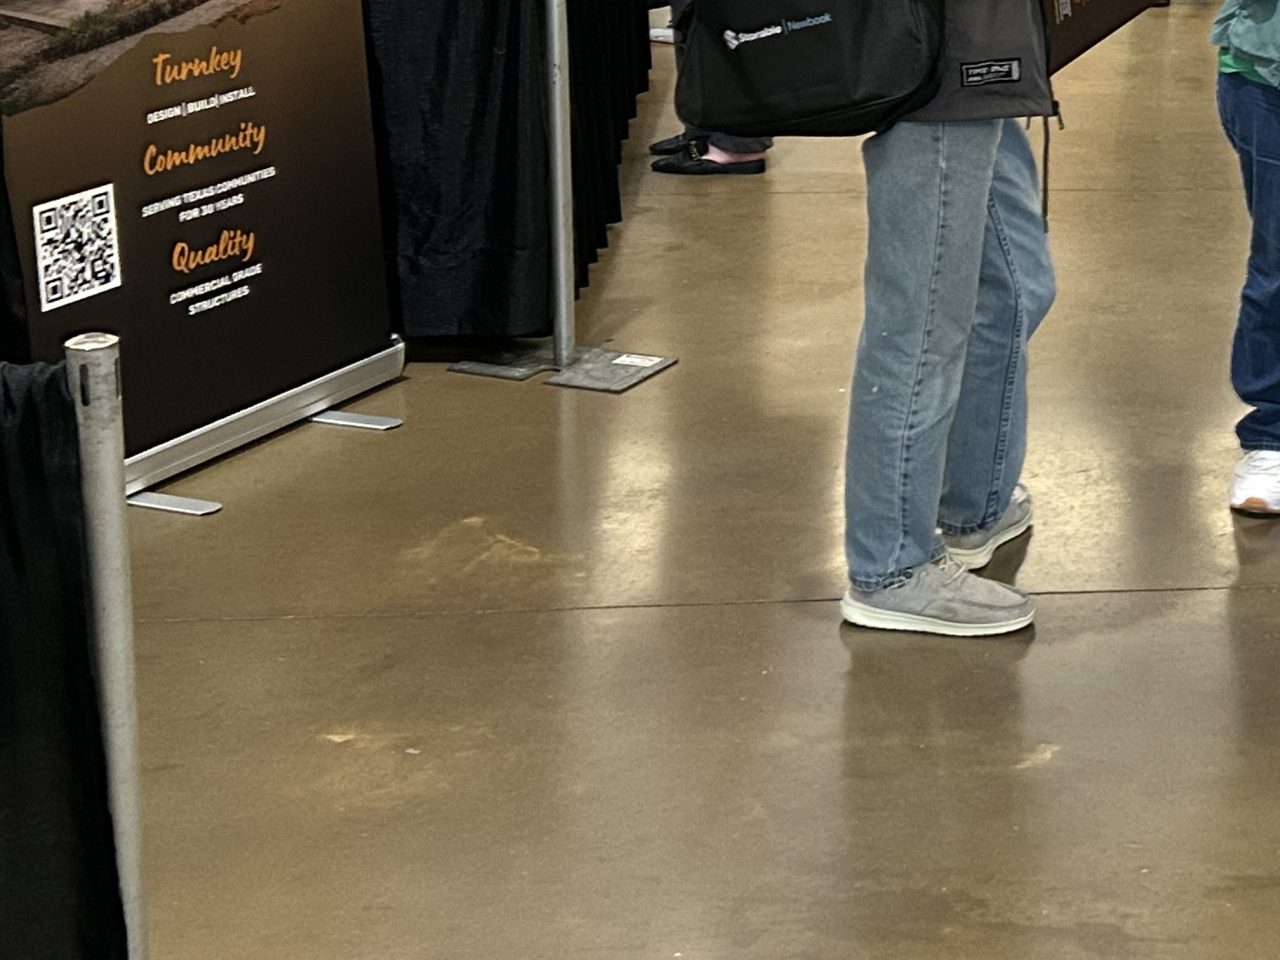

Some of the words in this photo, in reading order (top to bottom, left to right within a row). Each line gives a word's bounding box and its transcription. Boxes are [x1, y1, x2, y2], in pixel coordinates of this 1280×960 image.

[152, 46, 243, 86] Turnkey
[147, 105, 182, 124] DESIGN
[187, 96, 217, 114] BUILD
[219, 86, 256, 106] INSTALL
[143, 122, 266, 176] Community
[179, 207, 200, 222] FOR
[172, 230, 256, 273] Quality
[169, 277, 230, 305] COMMERCIAL
